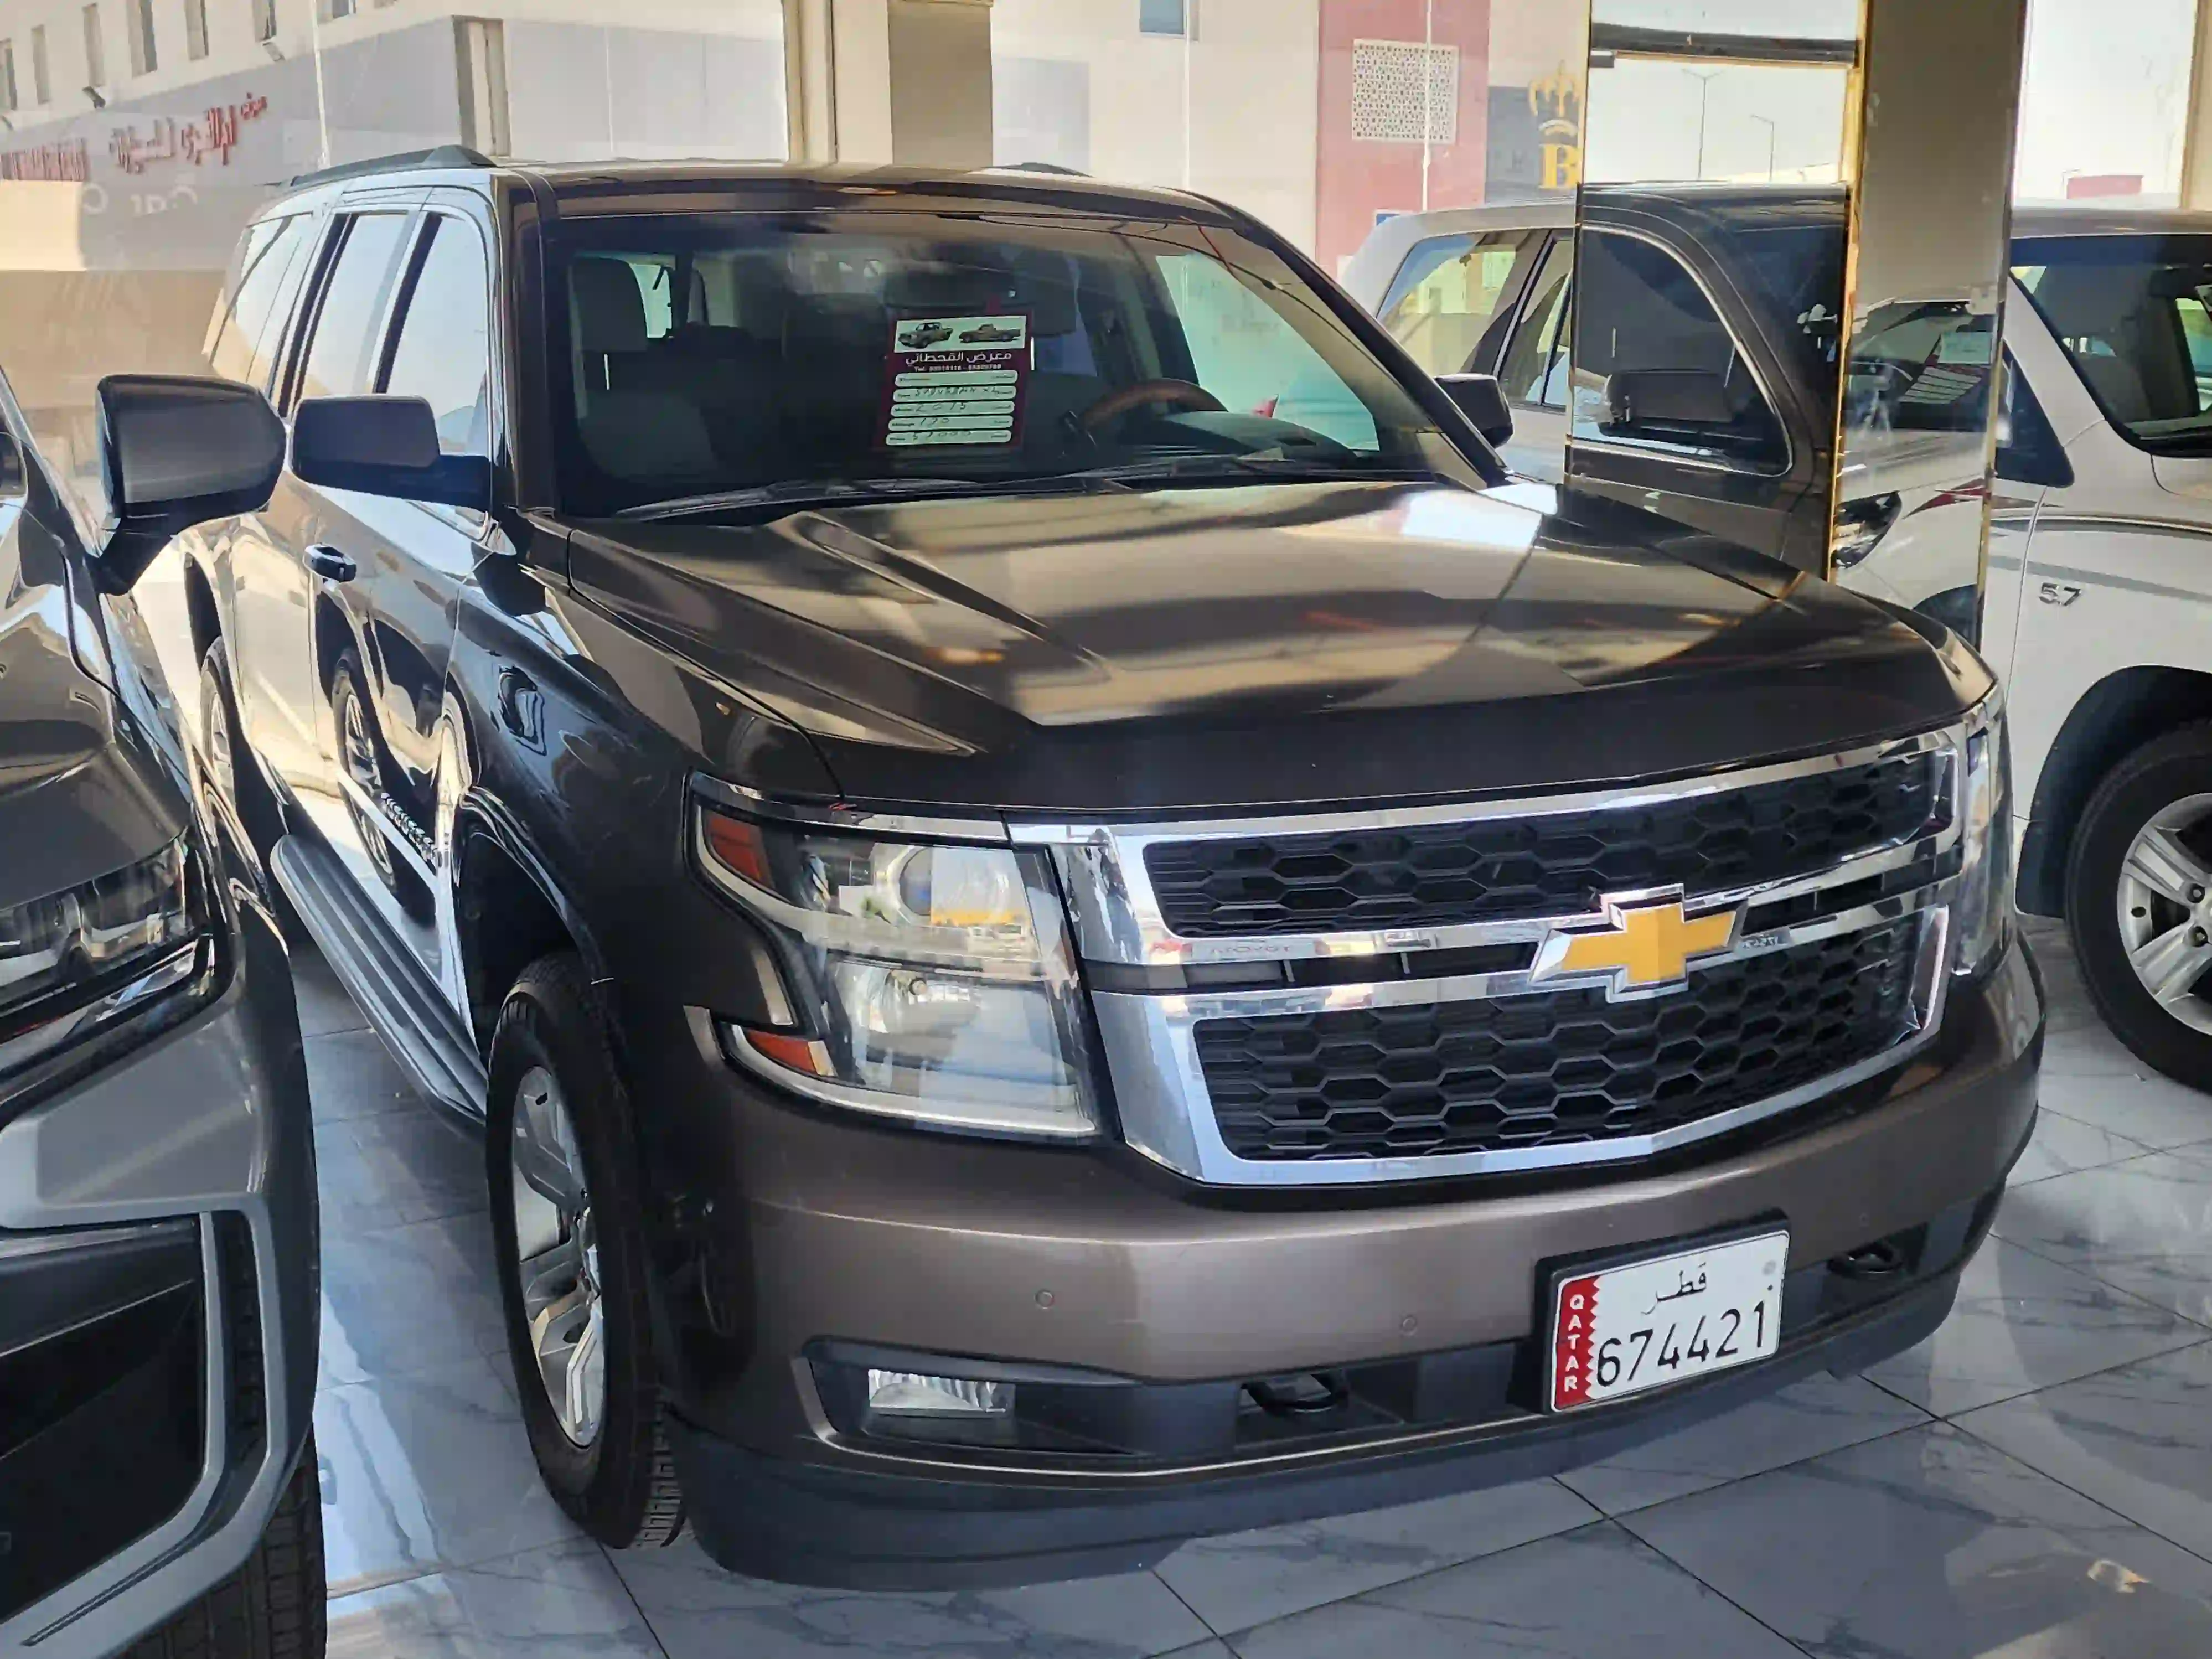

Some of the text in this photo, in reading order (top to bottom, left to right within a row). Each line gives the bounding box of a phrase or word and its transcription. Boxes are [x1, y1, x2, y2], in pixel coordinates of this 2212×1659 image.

[1538, 143, 1578, 189] B
[906, 352, 1012, 365] معرض القحطاني
[1641, 1262, 1707, 1315] قطر
[1564, 1294, 1585, 1393] QATAR
[1596, 1300, 1765, 1387] 674421
